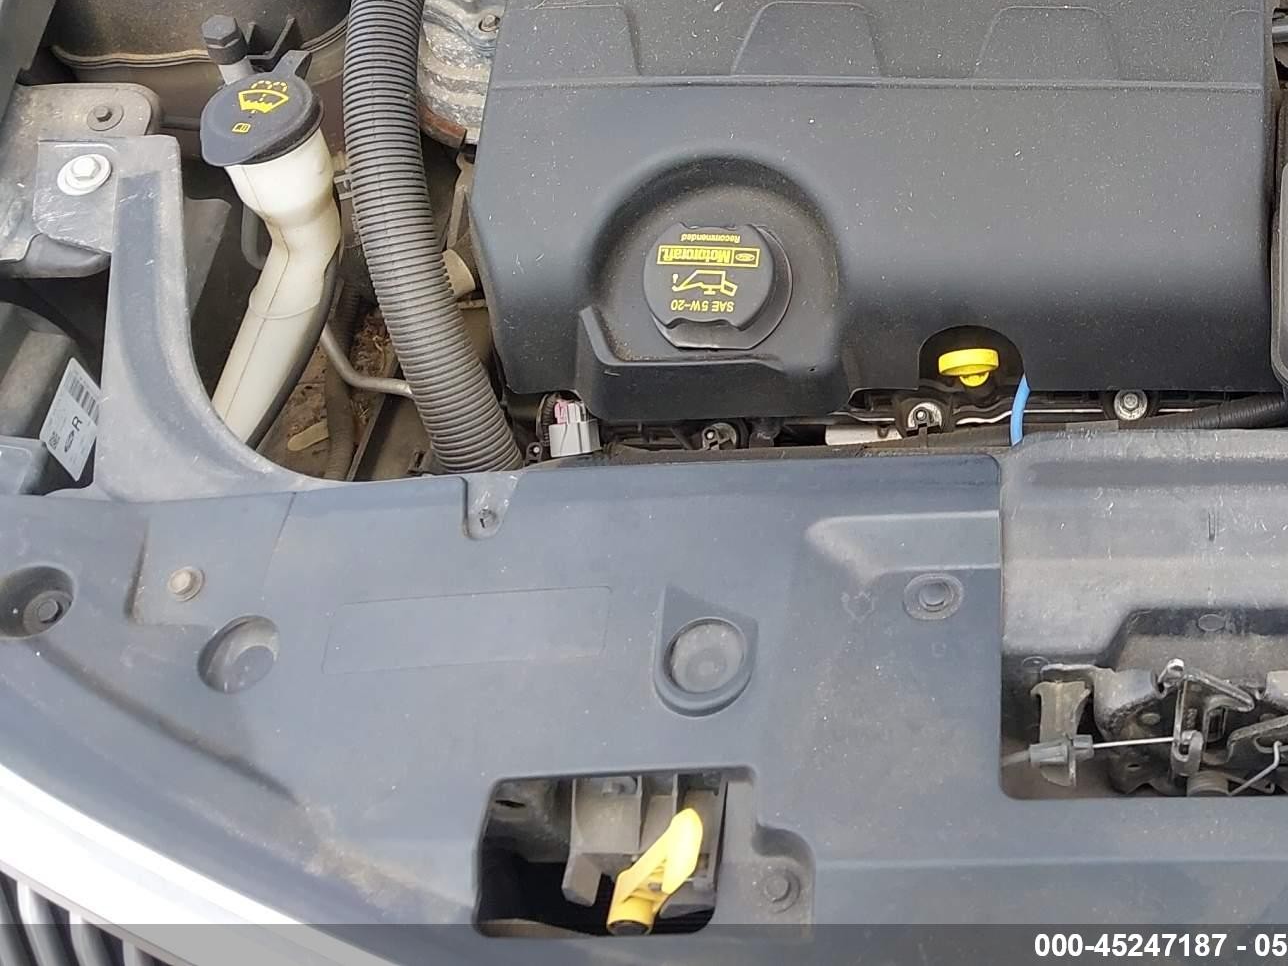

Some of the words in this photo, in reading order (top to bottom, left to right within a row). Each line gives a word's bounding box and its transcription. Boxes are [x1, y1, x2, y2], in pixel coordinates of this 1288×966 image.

[680, 233, 740, 243] Recommended
[670, 299, 709, 311] 5W-20
[711, 300, 735, 312] SAE
[71, 415, 82, 432] R
